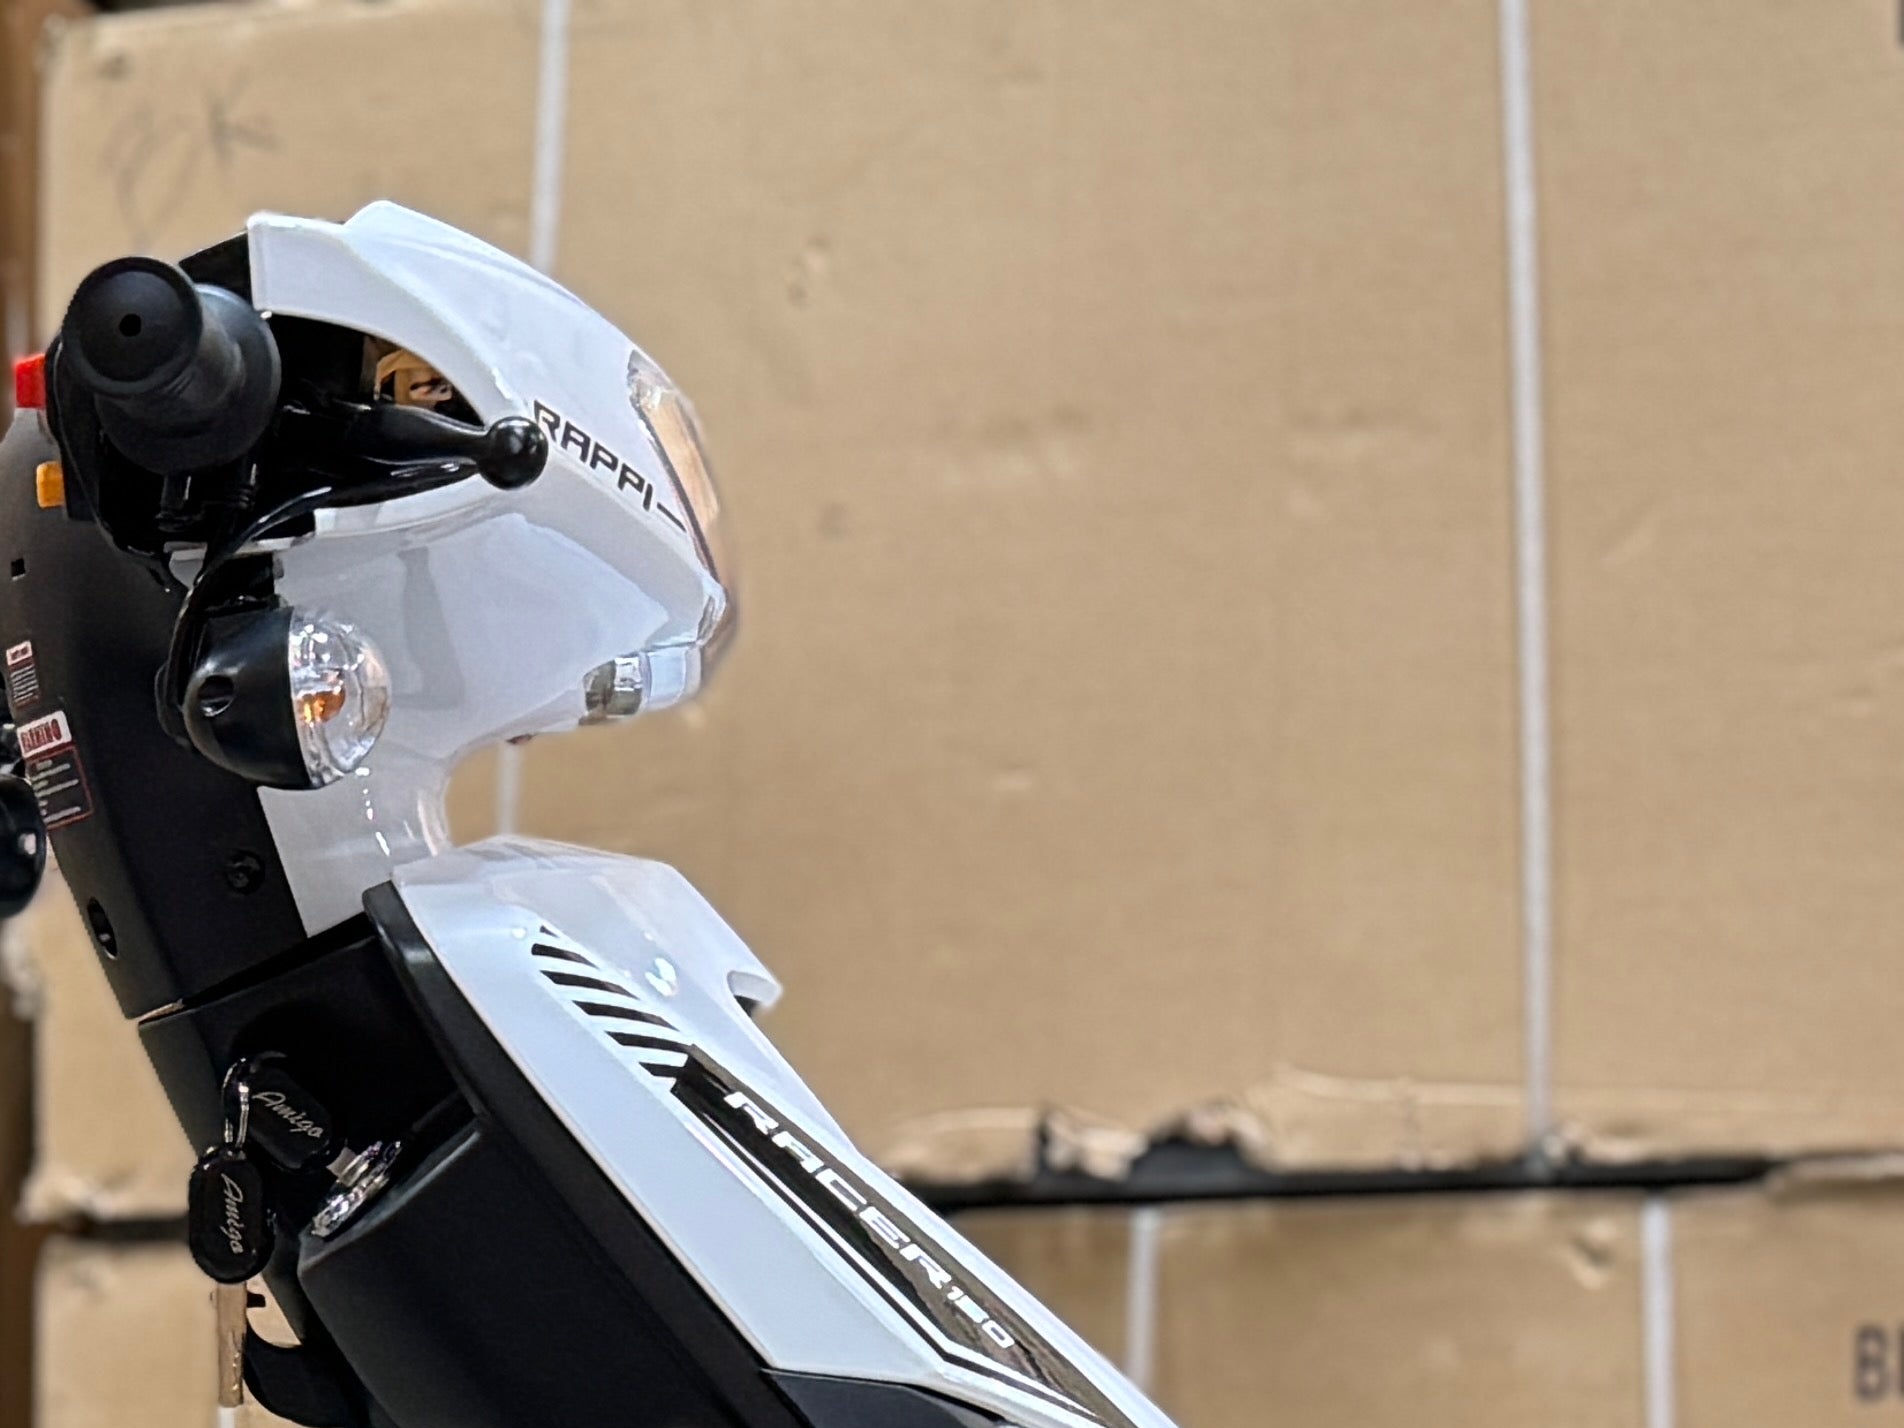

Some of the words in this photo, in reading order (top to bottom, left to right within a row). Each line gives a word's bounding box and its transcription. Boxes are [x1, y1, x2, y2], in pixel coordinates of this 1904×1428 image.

[533, 399, 655, 513] RAPPI
[251, 1090, 325, 1139] Amigo
[219, 1171, 245, 1255] Amigo
